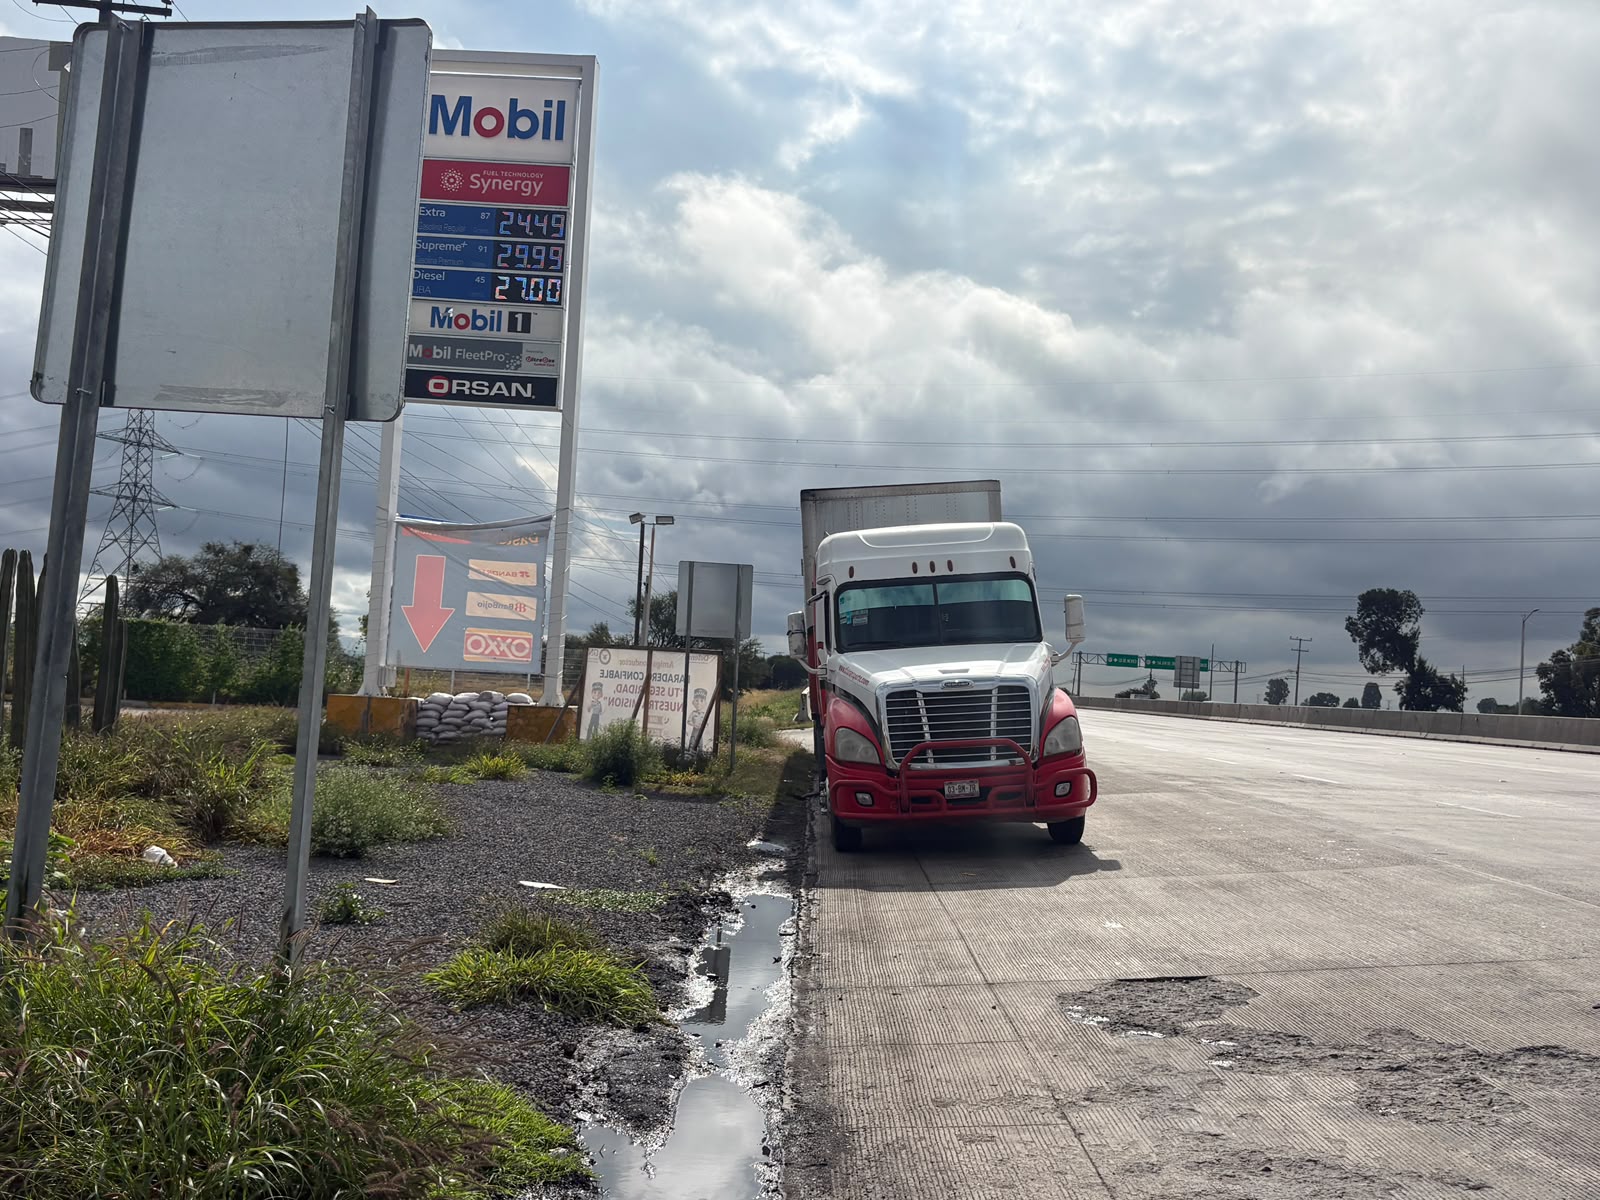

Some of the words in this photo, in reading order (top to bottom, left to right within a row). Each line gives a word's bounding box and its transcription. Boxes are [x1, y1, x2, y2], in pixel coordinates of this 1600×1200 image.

[429, 94, 566, 140] Mobil
[469, 174, 543, 196] Synergy
[419, 206, 446, 217] Extra
[499, 211, 565, 237] 24.49
[478, 245, 488, 253] 91
[497, 244, 563, 269] 29.99
[413, 270, 445, 281] Diesel
[495, 276, 561, 301] 27.00
[430, 306, 502, 332] Mobil
[408, 343, 451, 359] Mobil
[455, 348, 505, 362] FleetPro
[427, 377, 532, 398] ORSAN
